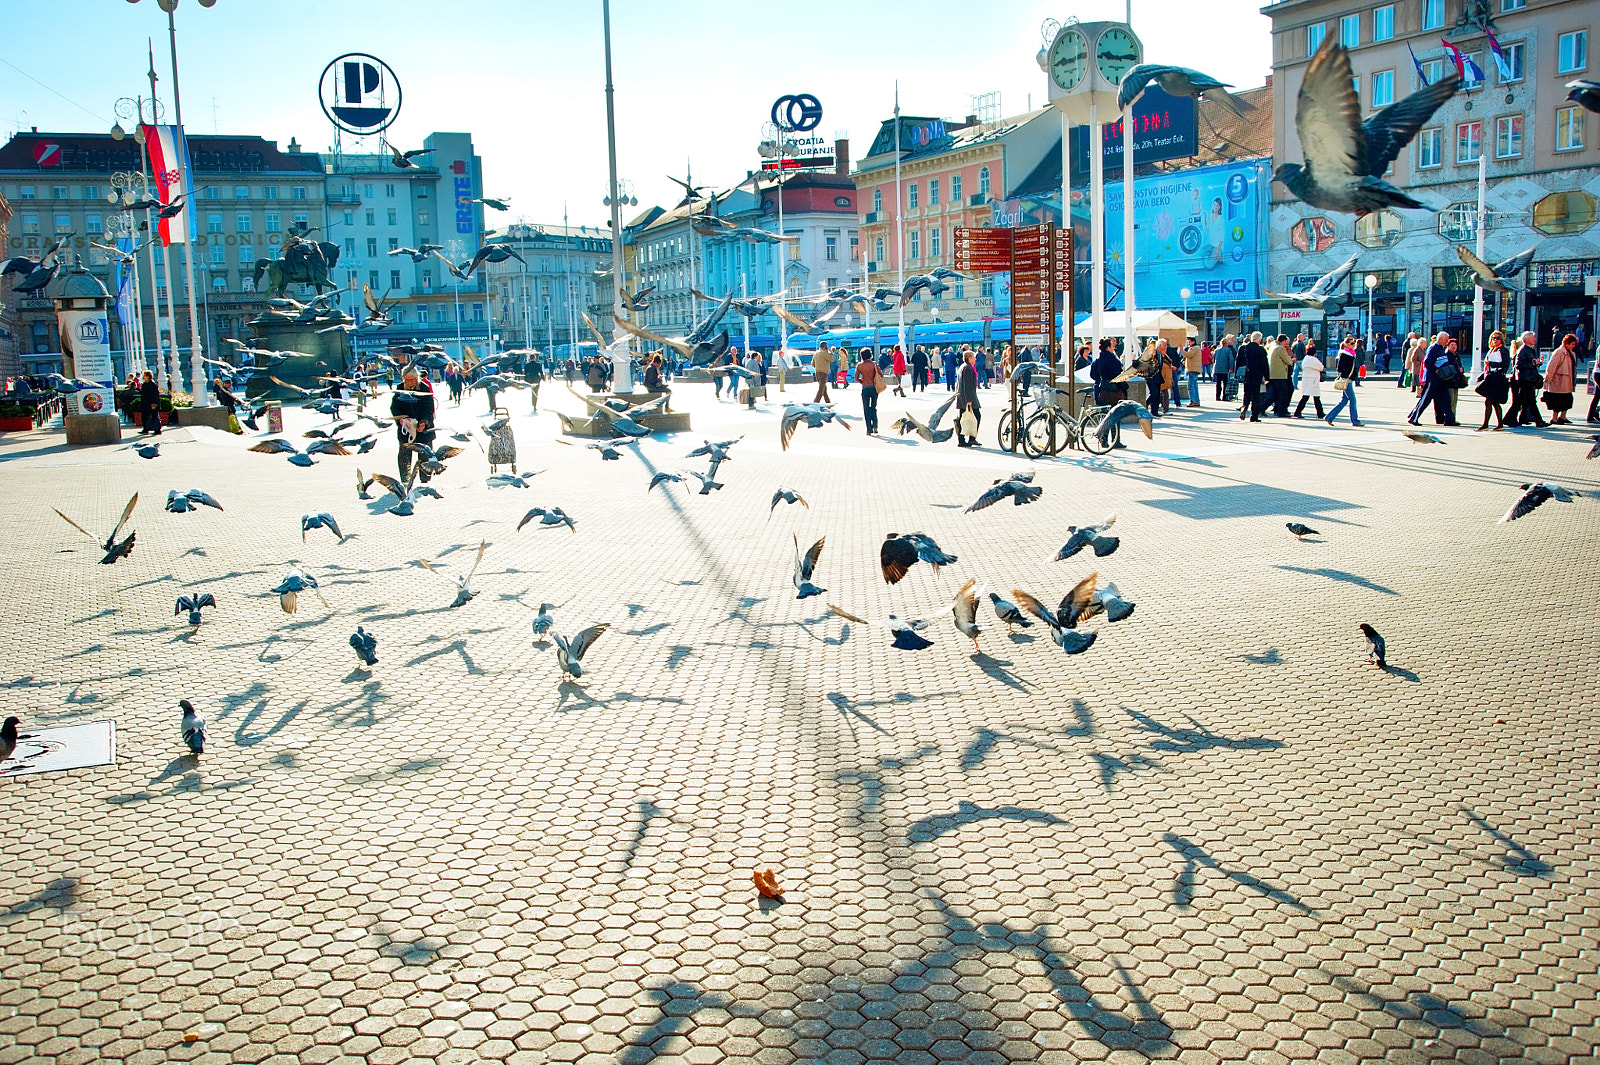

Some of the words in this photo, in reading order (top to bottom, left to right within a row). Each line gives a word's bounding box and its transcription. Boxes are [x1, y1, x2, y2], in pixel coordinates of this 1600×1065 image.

[912, 119, 946, 146] DONA
[1109, 187, 1158, 202] SAVNSTVO
[1160, 182, 1192, 196] HIGIJENE
[1232, 175, 1242, 193] 5
[454, 177, 473, 234] ERSTE
[1109, 199, 1150, 212] OSIGAVA
[1151, 196, 1170, 207] BEKO
[994, 207, 1024, 228] Zagrli
[1538, 262, 1592, 274] AMERICAN
[1193, 278, 1247, 294] BEKO
[1280, 311, 1301, 319] TISAK
